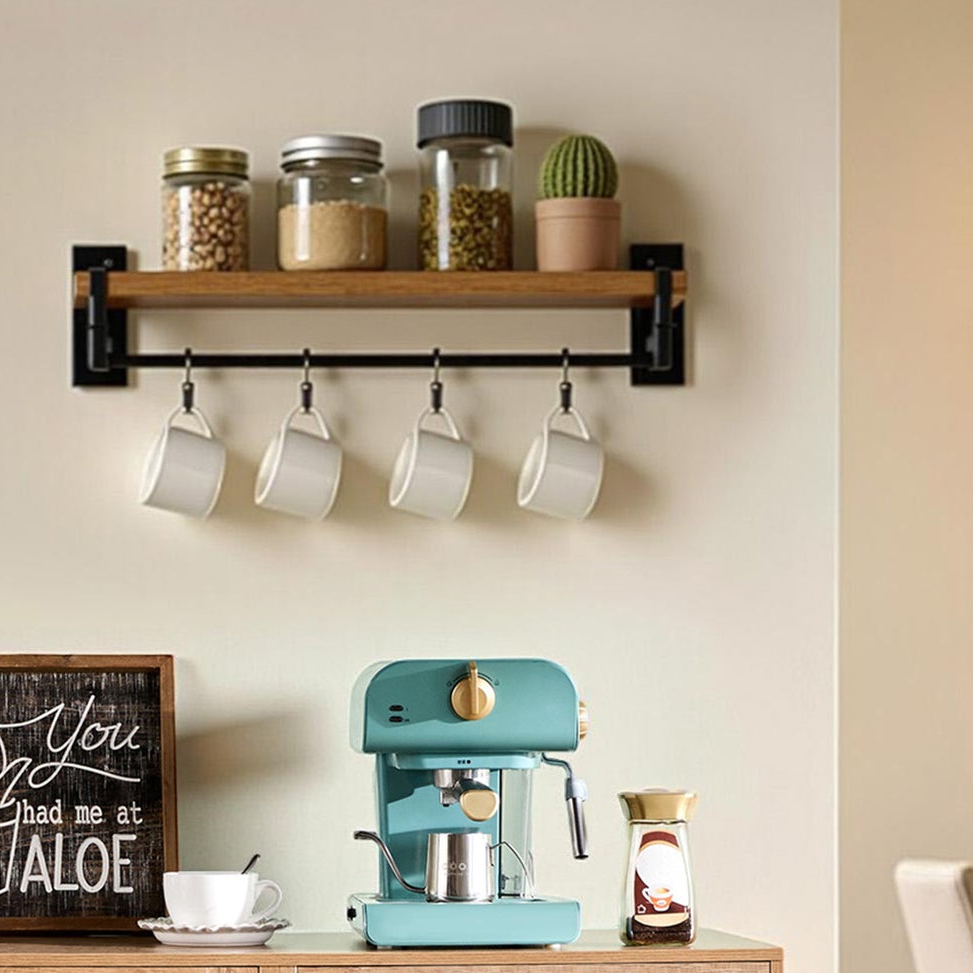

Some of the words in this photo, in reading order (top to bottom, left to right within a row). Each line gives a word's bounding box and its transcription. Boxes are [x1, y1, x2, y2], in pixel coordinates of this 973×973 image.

[0, 695, 140, 788] You
[22, 799, 63, 825] had
[74, 804, 103, 825] me
[116, 801, 143, 825] at
[19, 833, 137, 893] ALOE
